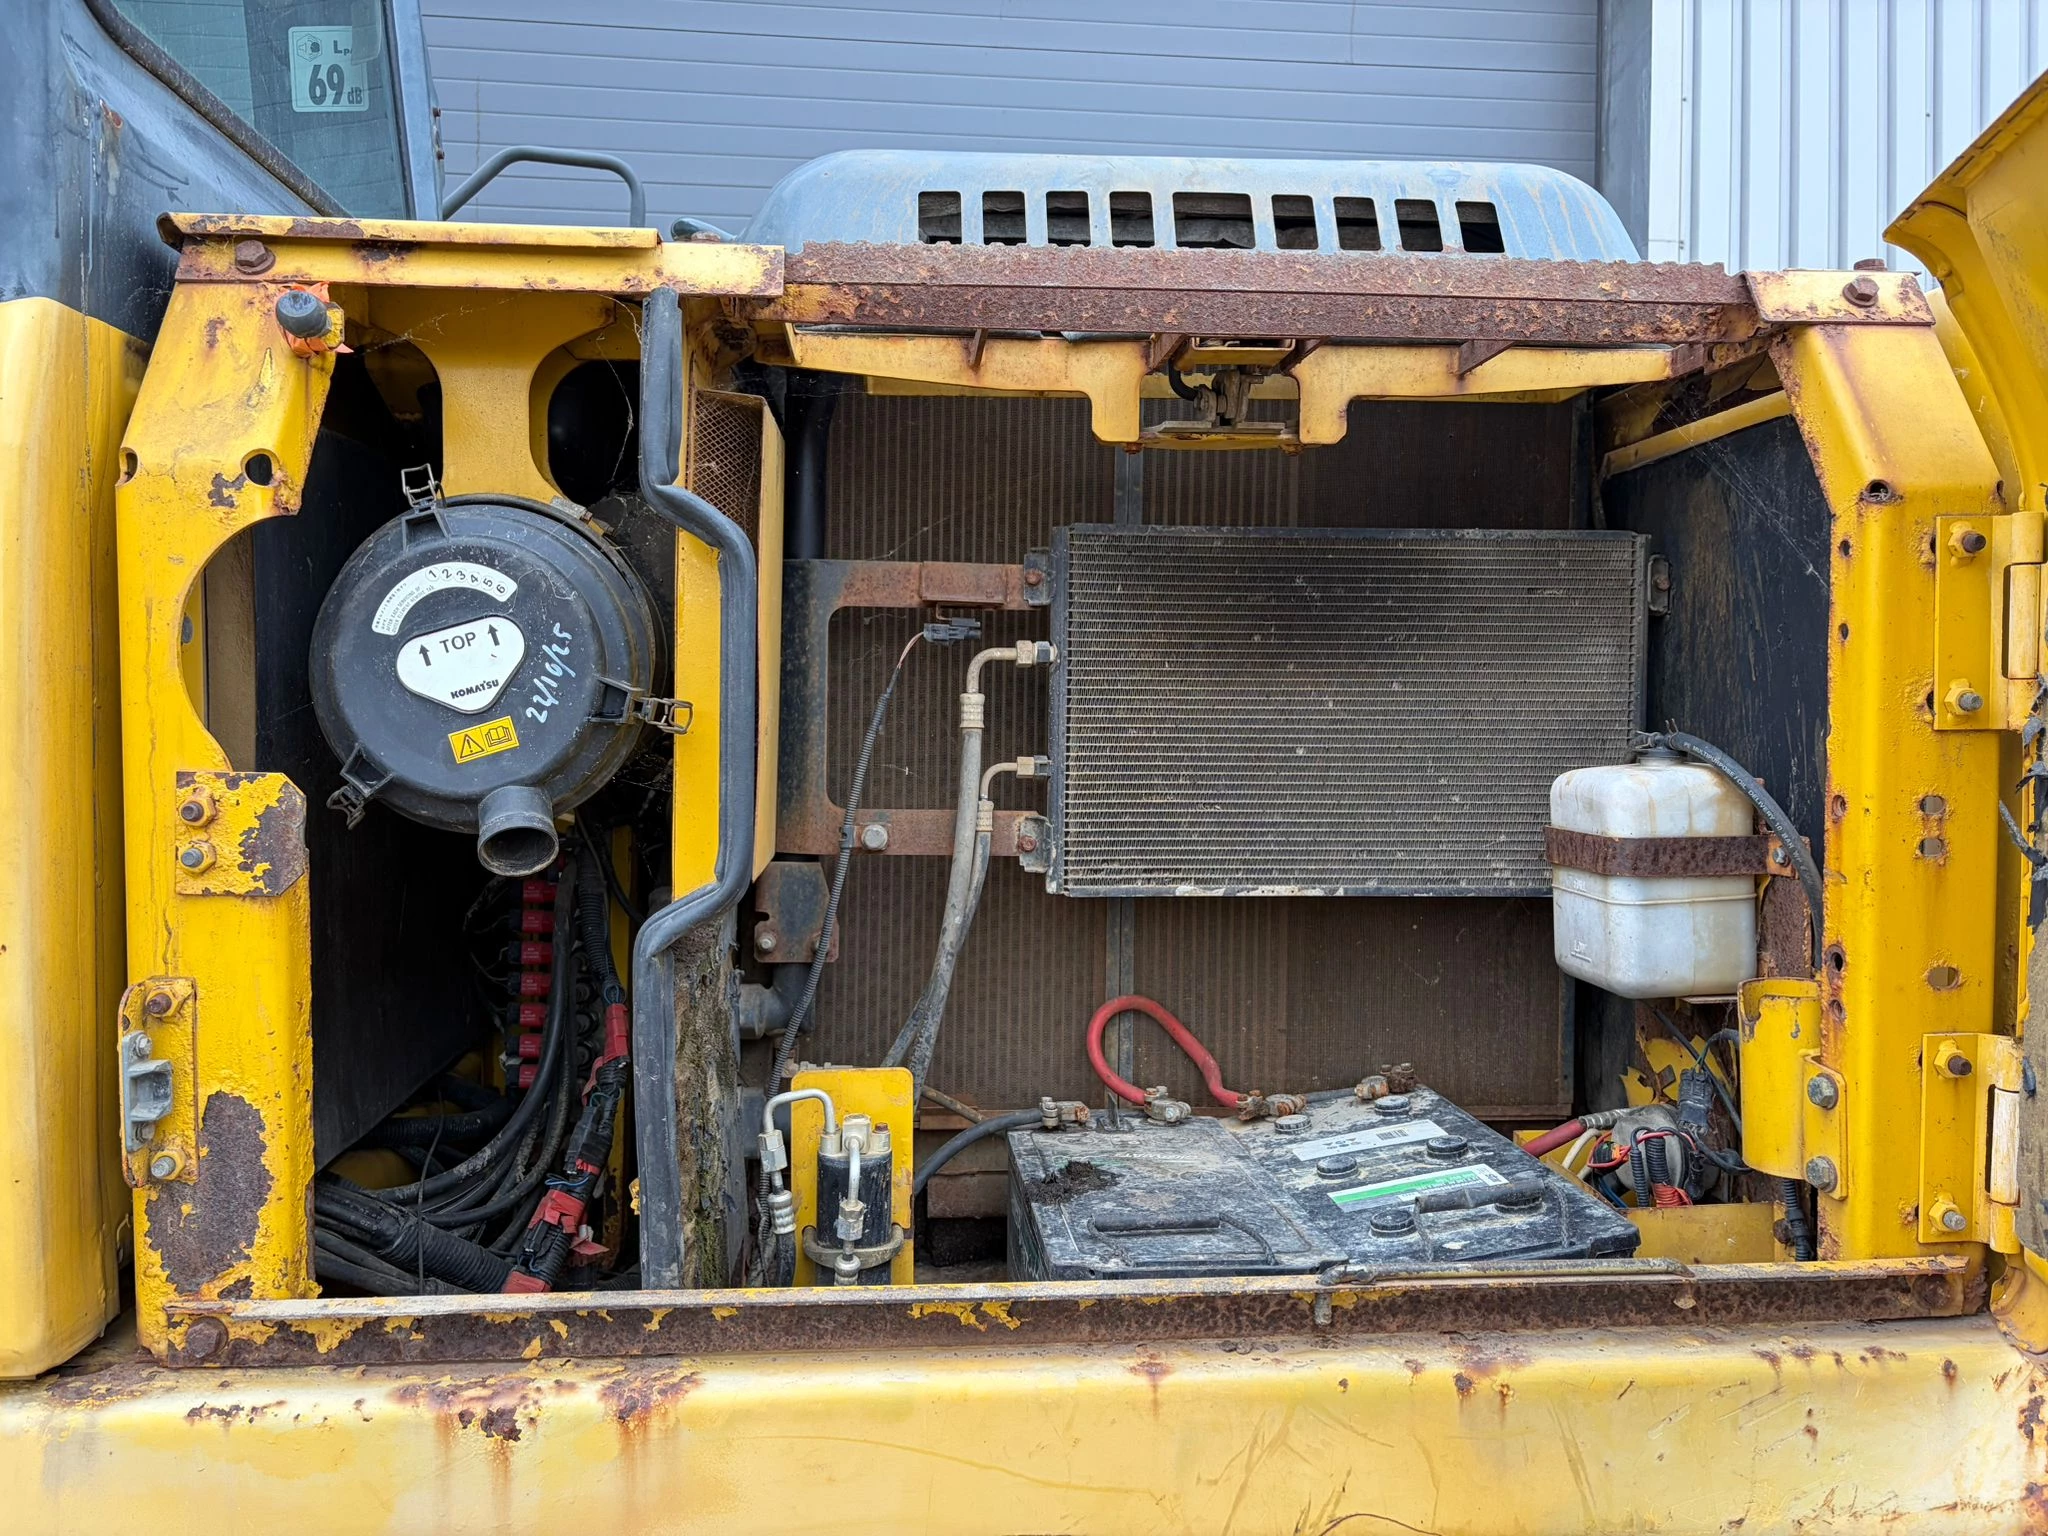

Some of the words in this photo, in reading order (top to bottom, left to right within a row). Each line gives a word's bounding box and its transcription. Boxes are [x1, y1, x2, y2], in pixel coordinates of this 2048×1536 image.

[333, 40, 352, 55] Lp
[308, 64, 345, 105] 69
[347, 86, 363, 105] dB
[428, 569, 437, 578] 1
[442, 568, 452, 579] 2
[456, 570, 466, 580] 3
[469, 574, 479, 584] 4
[482, 578, 493, 587] 5
[496, 584, 506, 594] 6
[439, 631, 476, 653] TOP
[450, 679, 500, 699] KOMATSU
[1748, 789, 1776, 820] DELIVERY
[1774, 822, 1783, 832] 10
